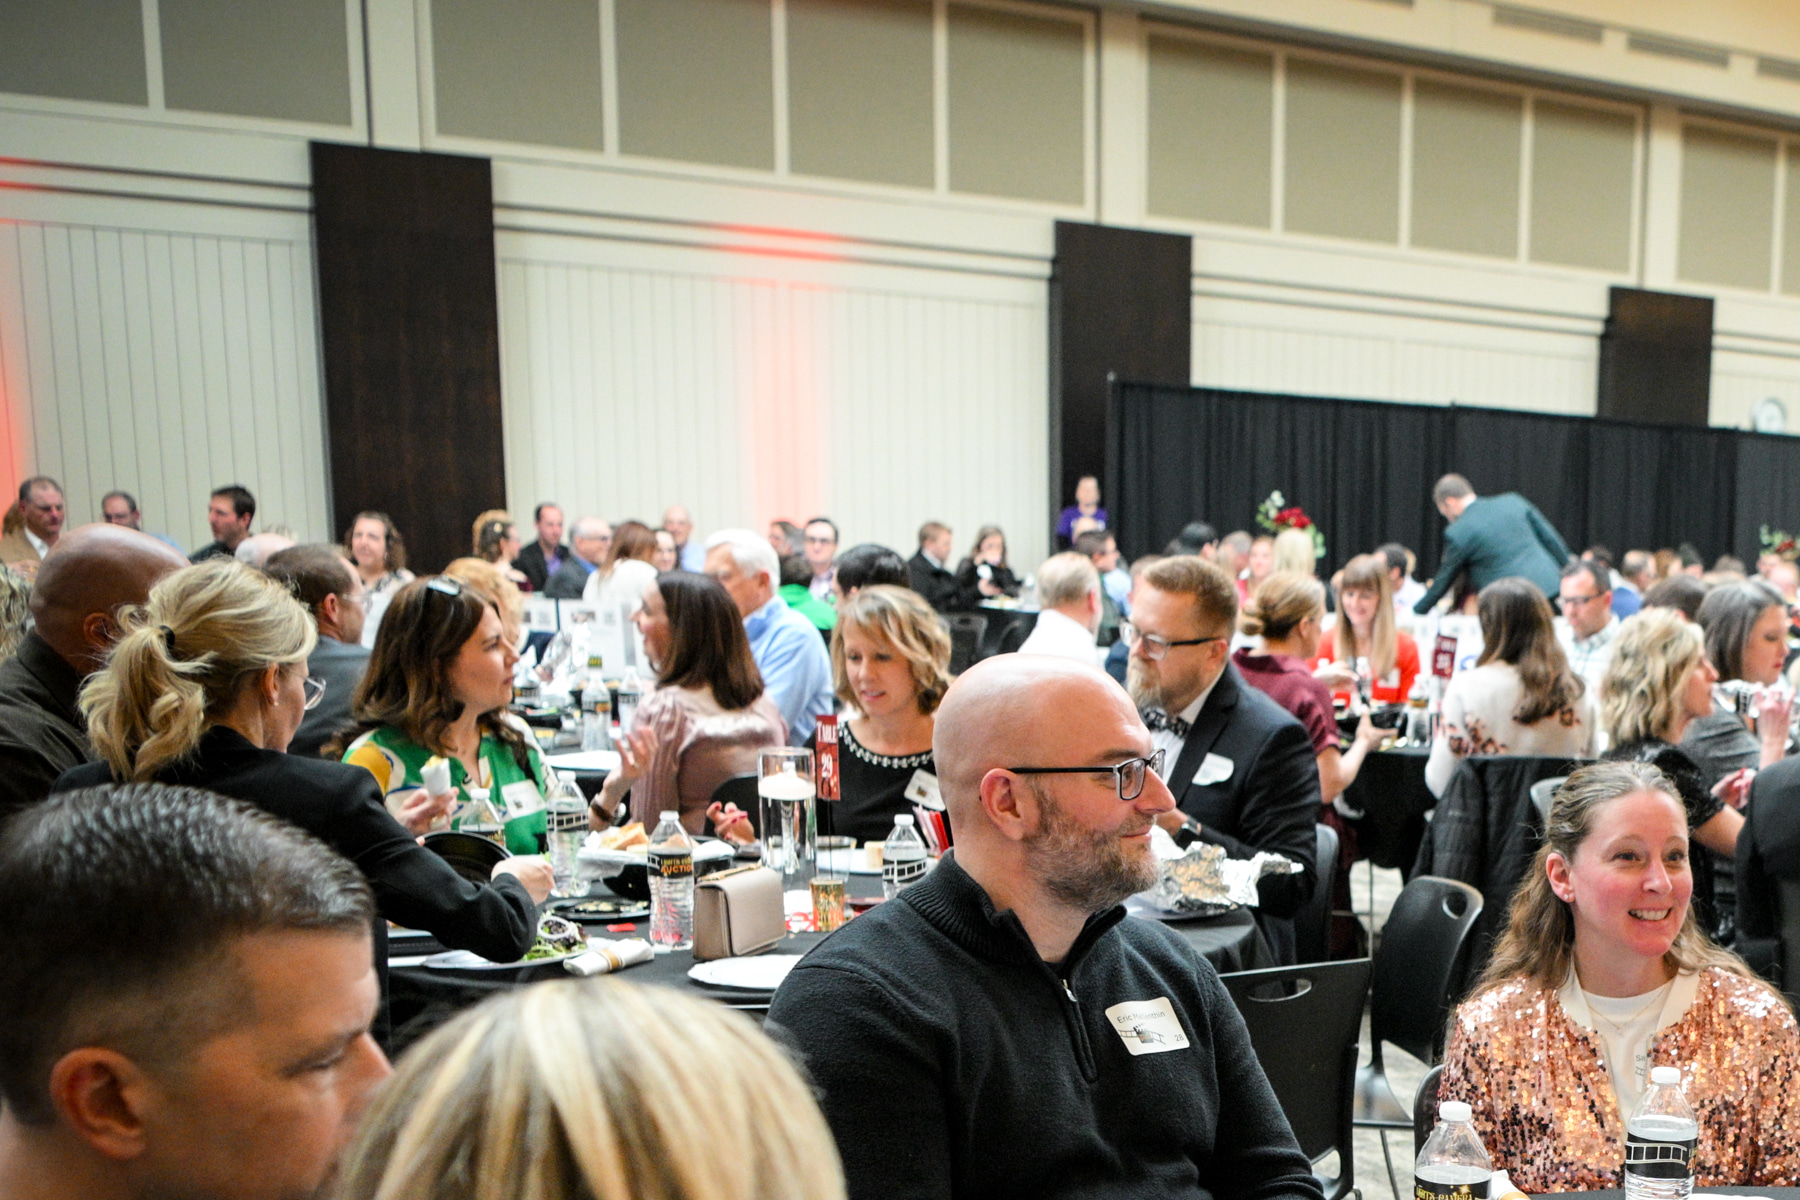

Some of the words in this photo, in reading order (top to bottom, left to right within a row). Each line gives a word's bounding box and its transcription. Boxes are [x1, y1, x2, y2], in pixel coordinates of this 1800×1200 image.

[821, 753, 833, 778] 29
[660, 864, 693, 873] AUCTIO
[1117, 1015, 1133, 1024] Eric
